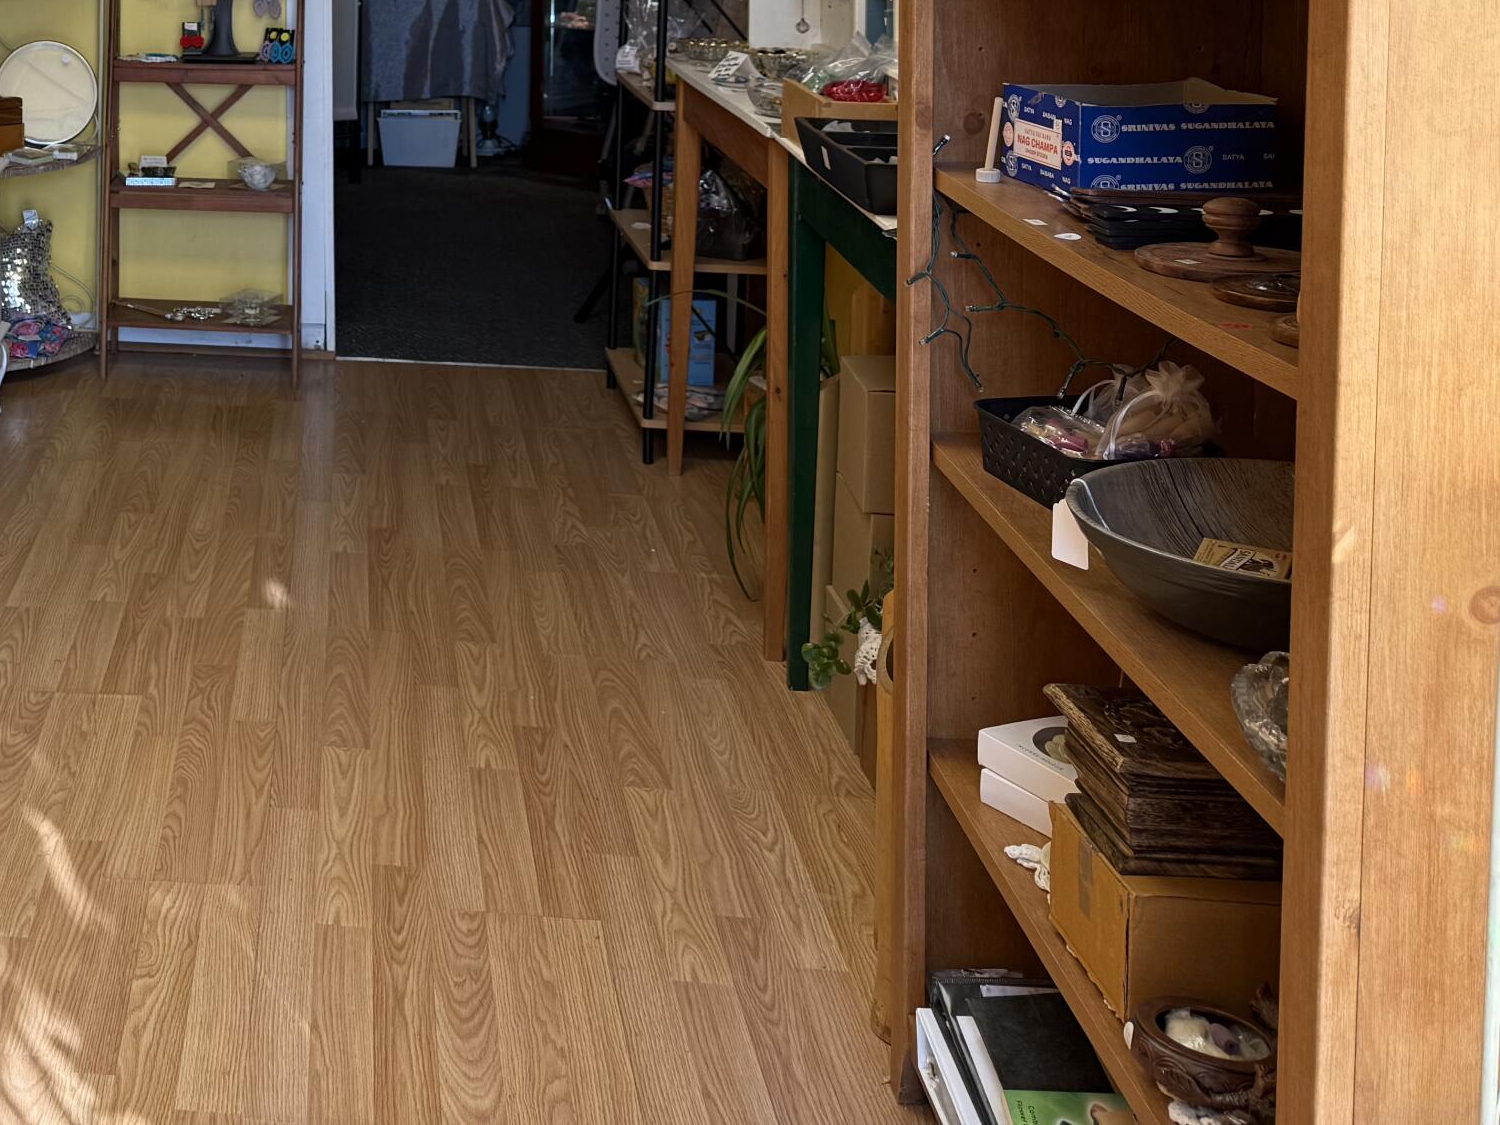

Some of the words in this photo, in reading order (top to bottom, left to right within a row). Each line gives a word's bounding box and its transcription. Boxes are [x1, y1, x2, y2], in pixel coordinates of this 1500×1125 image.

[1121, 123, 1176, 132] SRINIVAS
[1180, 121, 1276, 130] SUGANDHALAYA
[1017, 135, 1031, 146] NAG
[1030, 138, 1058, 155] CHAMPA
[1087, 156, 1183, 165] SUGANDHALAYA
[1222, 153, 1245, 161] SATYA
[1179, 181, 1274, 190] SUGANDHALAYA
